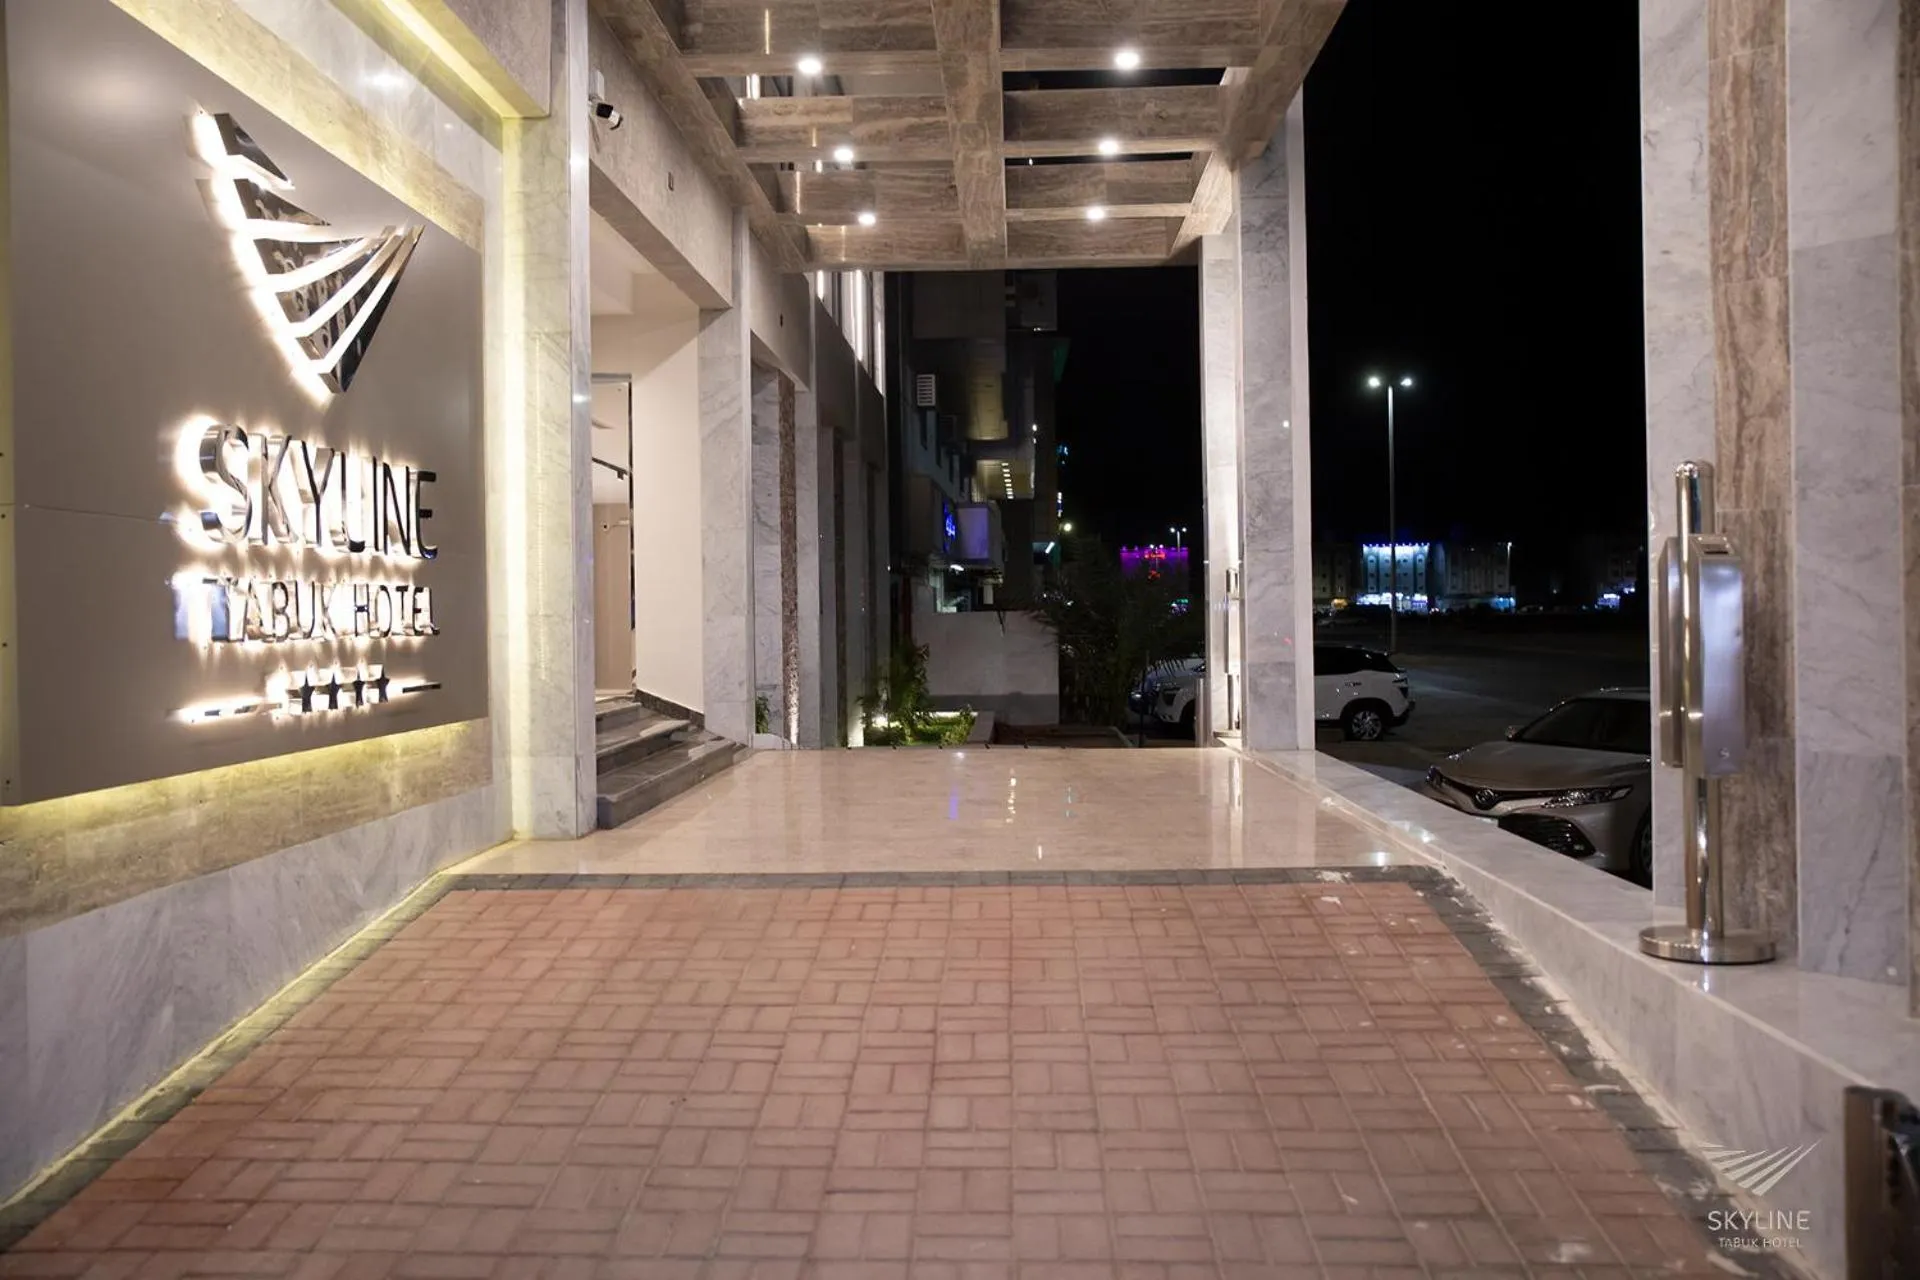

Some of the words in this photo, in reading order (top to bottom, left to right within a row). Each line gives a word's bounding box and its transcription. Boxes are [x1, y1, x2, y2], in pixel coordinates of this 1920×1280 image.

[199, 423, 439, 560] SKYLINE
[200, 575, 337, 643] TABUK
[351, 582, 441, 638] HOTEL
